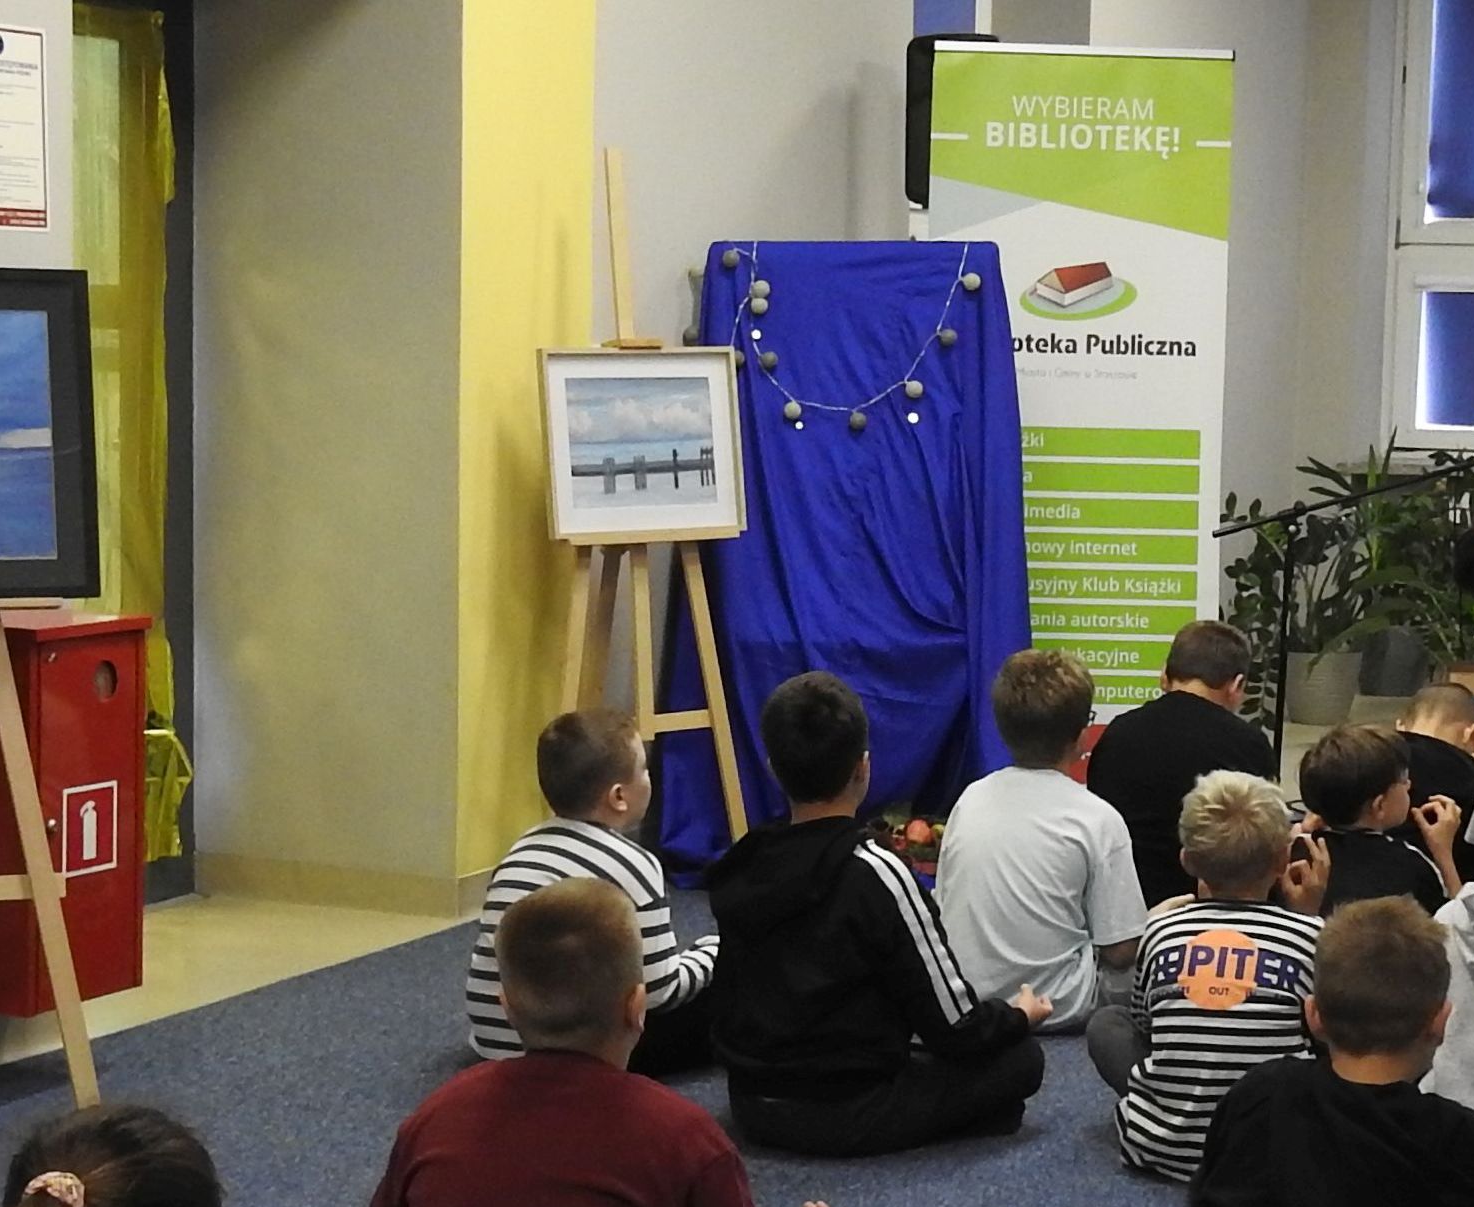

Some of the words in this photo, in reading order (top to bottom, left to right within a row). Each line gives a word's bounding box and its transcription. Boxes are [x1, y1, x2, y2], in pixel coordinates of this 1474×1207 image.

[1012, 95, 1155, 120] WYBIERAM
[985, 121, 1181, 159] BIBLIOTEKĘ!
[1086, 333, 1197, 357] Publiczna
[1083, 576, 1120, 593] Klub
[1124, 577, 1182, 597] Książki
[1070, 611, 1150, 629] autorskie
